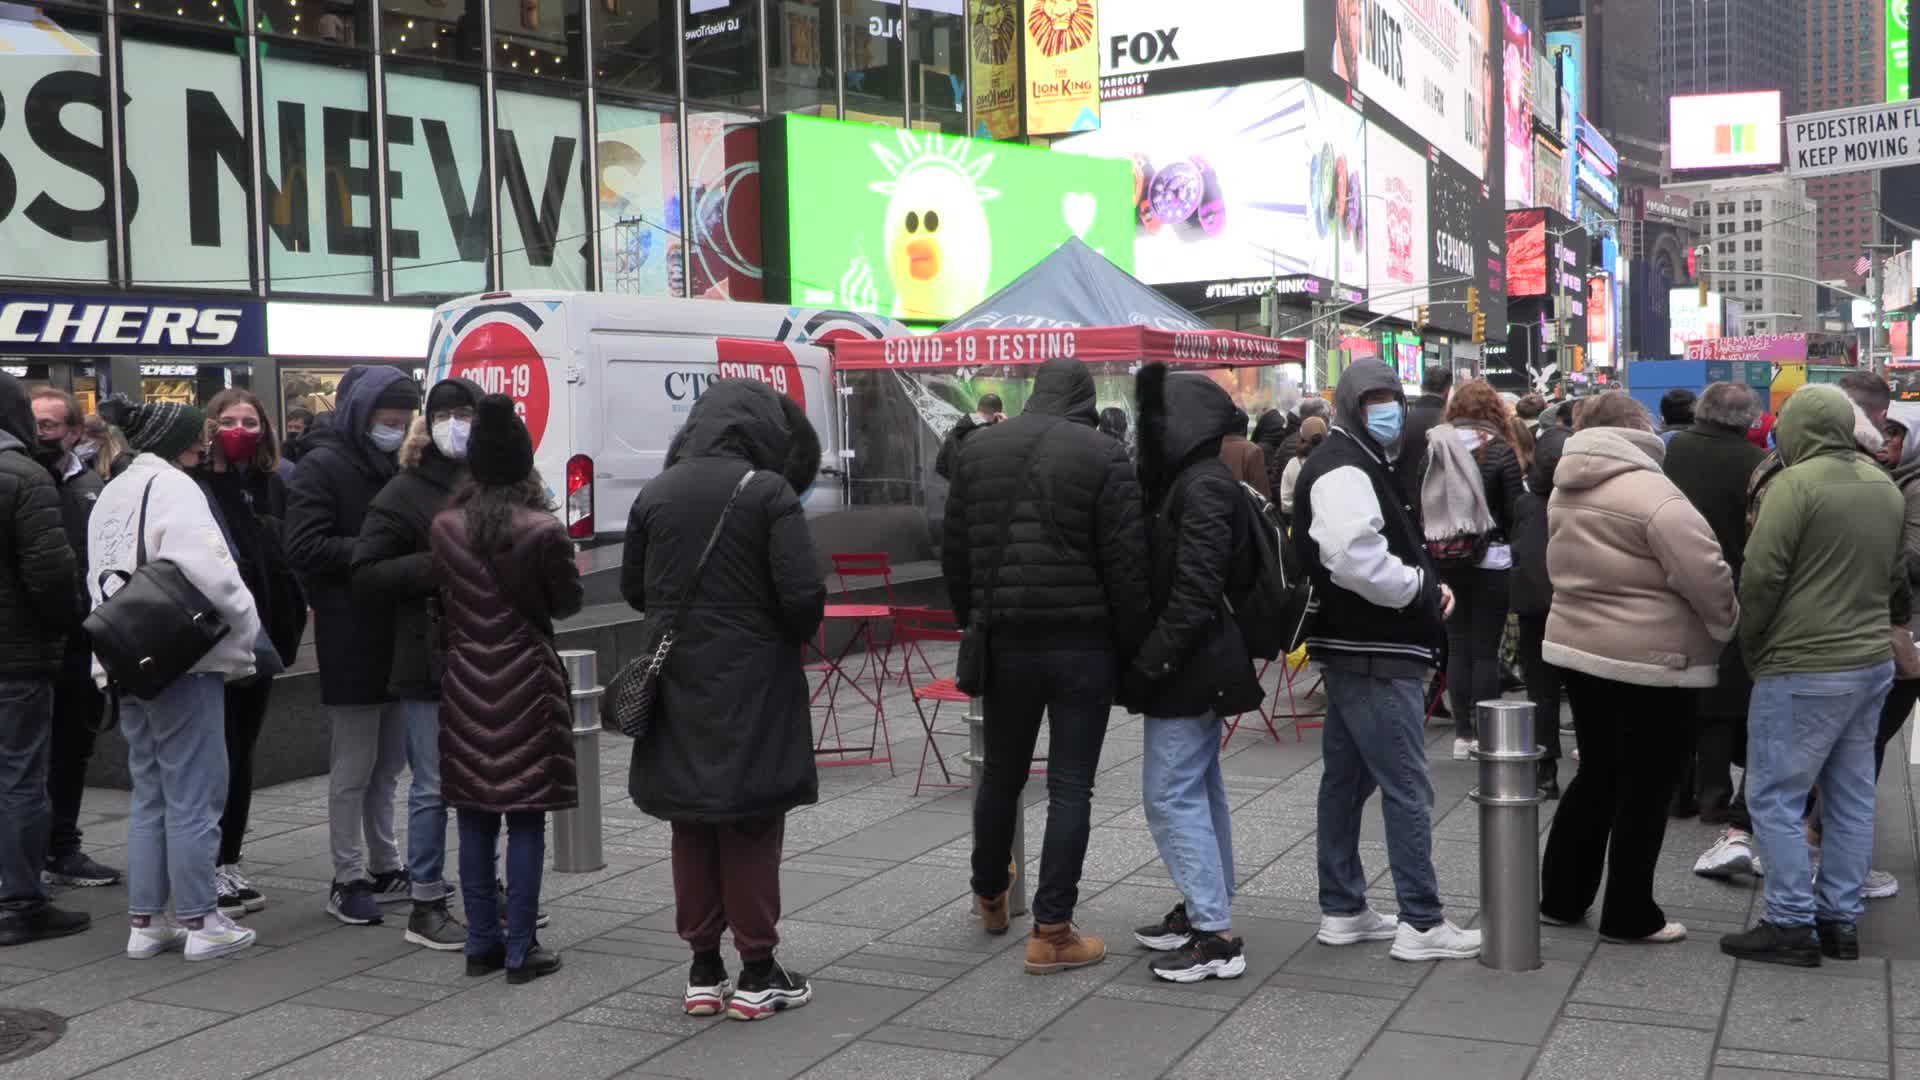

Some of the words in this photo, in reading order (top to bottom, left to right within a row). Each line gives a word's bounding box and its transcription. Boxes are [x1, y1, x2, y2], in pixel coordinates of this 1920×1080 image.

[1110, 27, 1180, 69] FOX
[1797, 112, 1899, 142] PEDESTRIAN
[1799, 146, 1838, 168] KEEP
[1845, 137, 1908, 162] MOVING
[1437, 230, 1474, 278] SEPHORA
[884, 335, 977, 364] COVID-19
[986, 332, 1075, 361] TESTING
